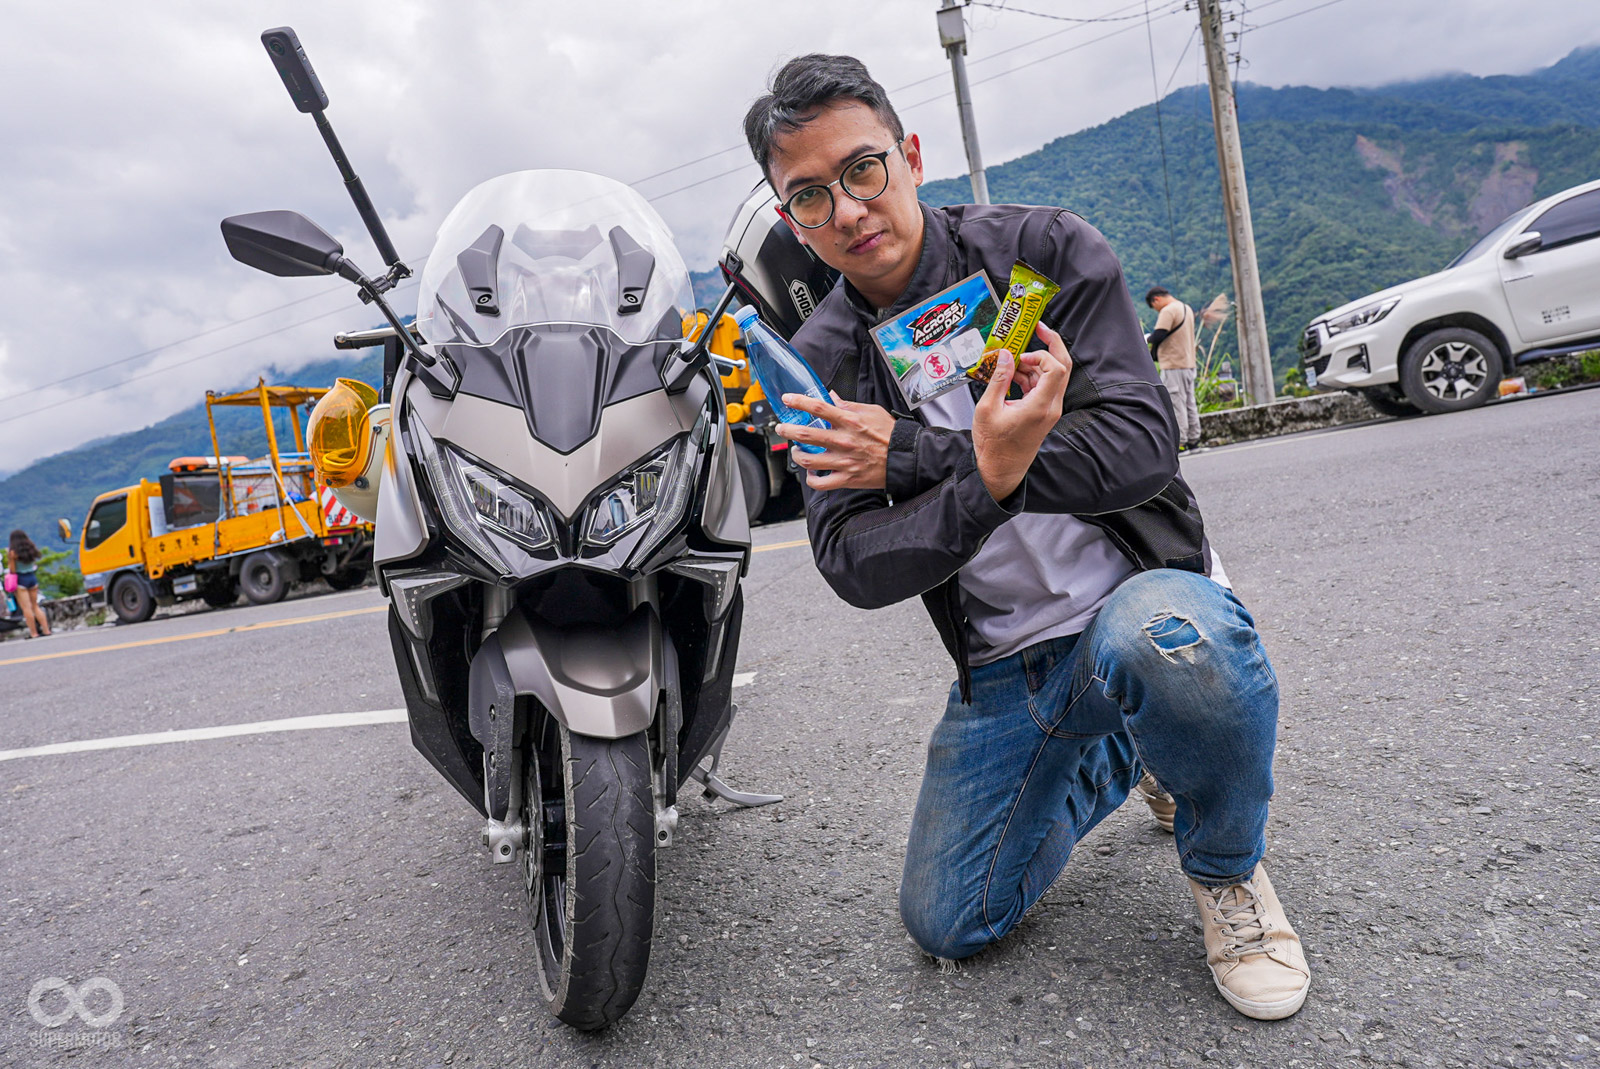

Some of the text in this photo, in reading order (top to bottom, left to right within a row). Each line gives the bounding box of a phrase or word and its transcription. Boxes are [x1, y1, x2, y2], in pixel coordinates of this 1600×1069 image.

[793, 287, 813, 318] SHOE
[944, 306, 965, 329] DAY
[1020, 294, 1041, 328] NATURE
[914, 301, 960, 343] ACROSS
[994, 301, 1021, 342] CRUNCHY
